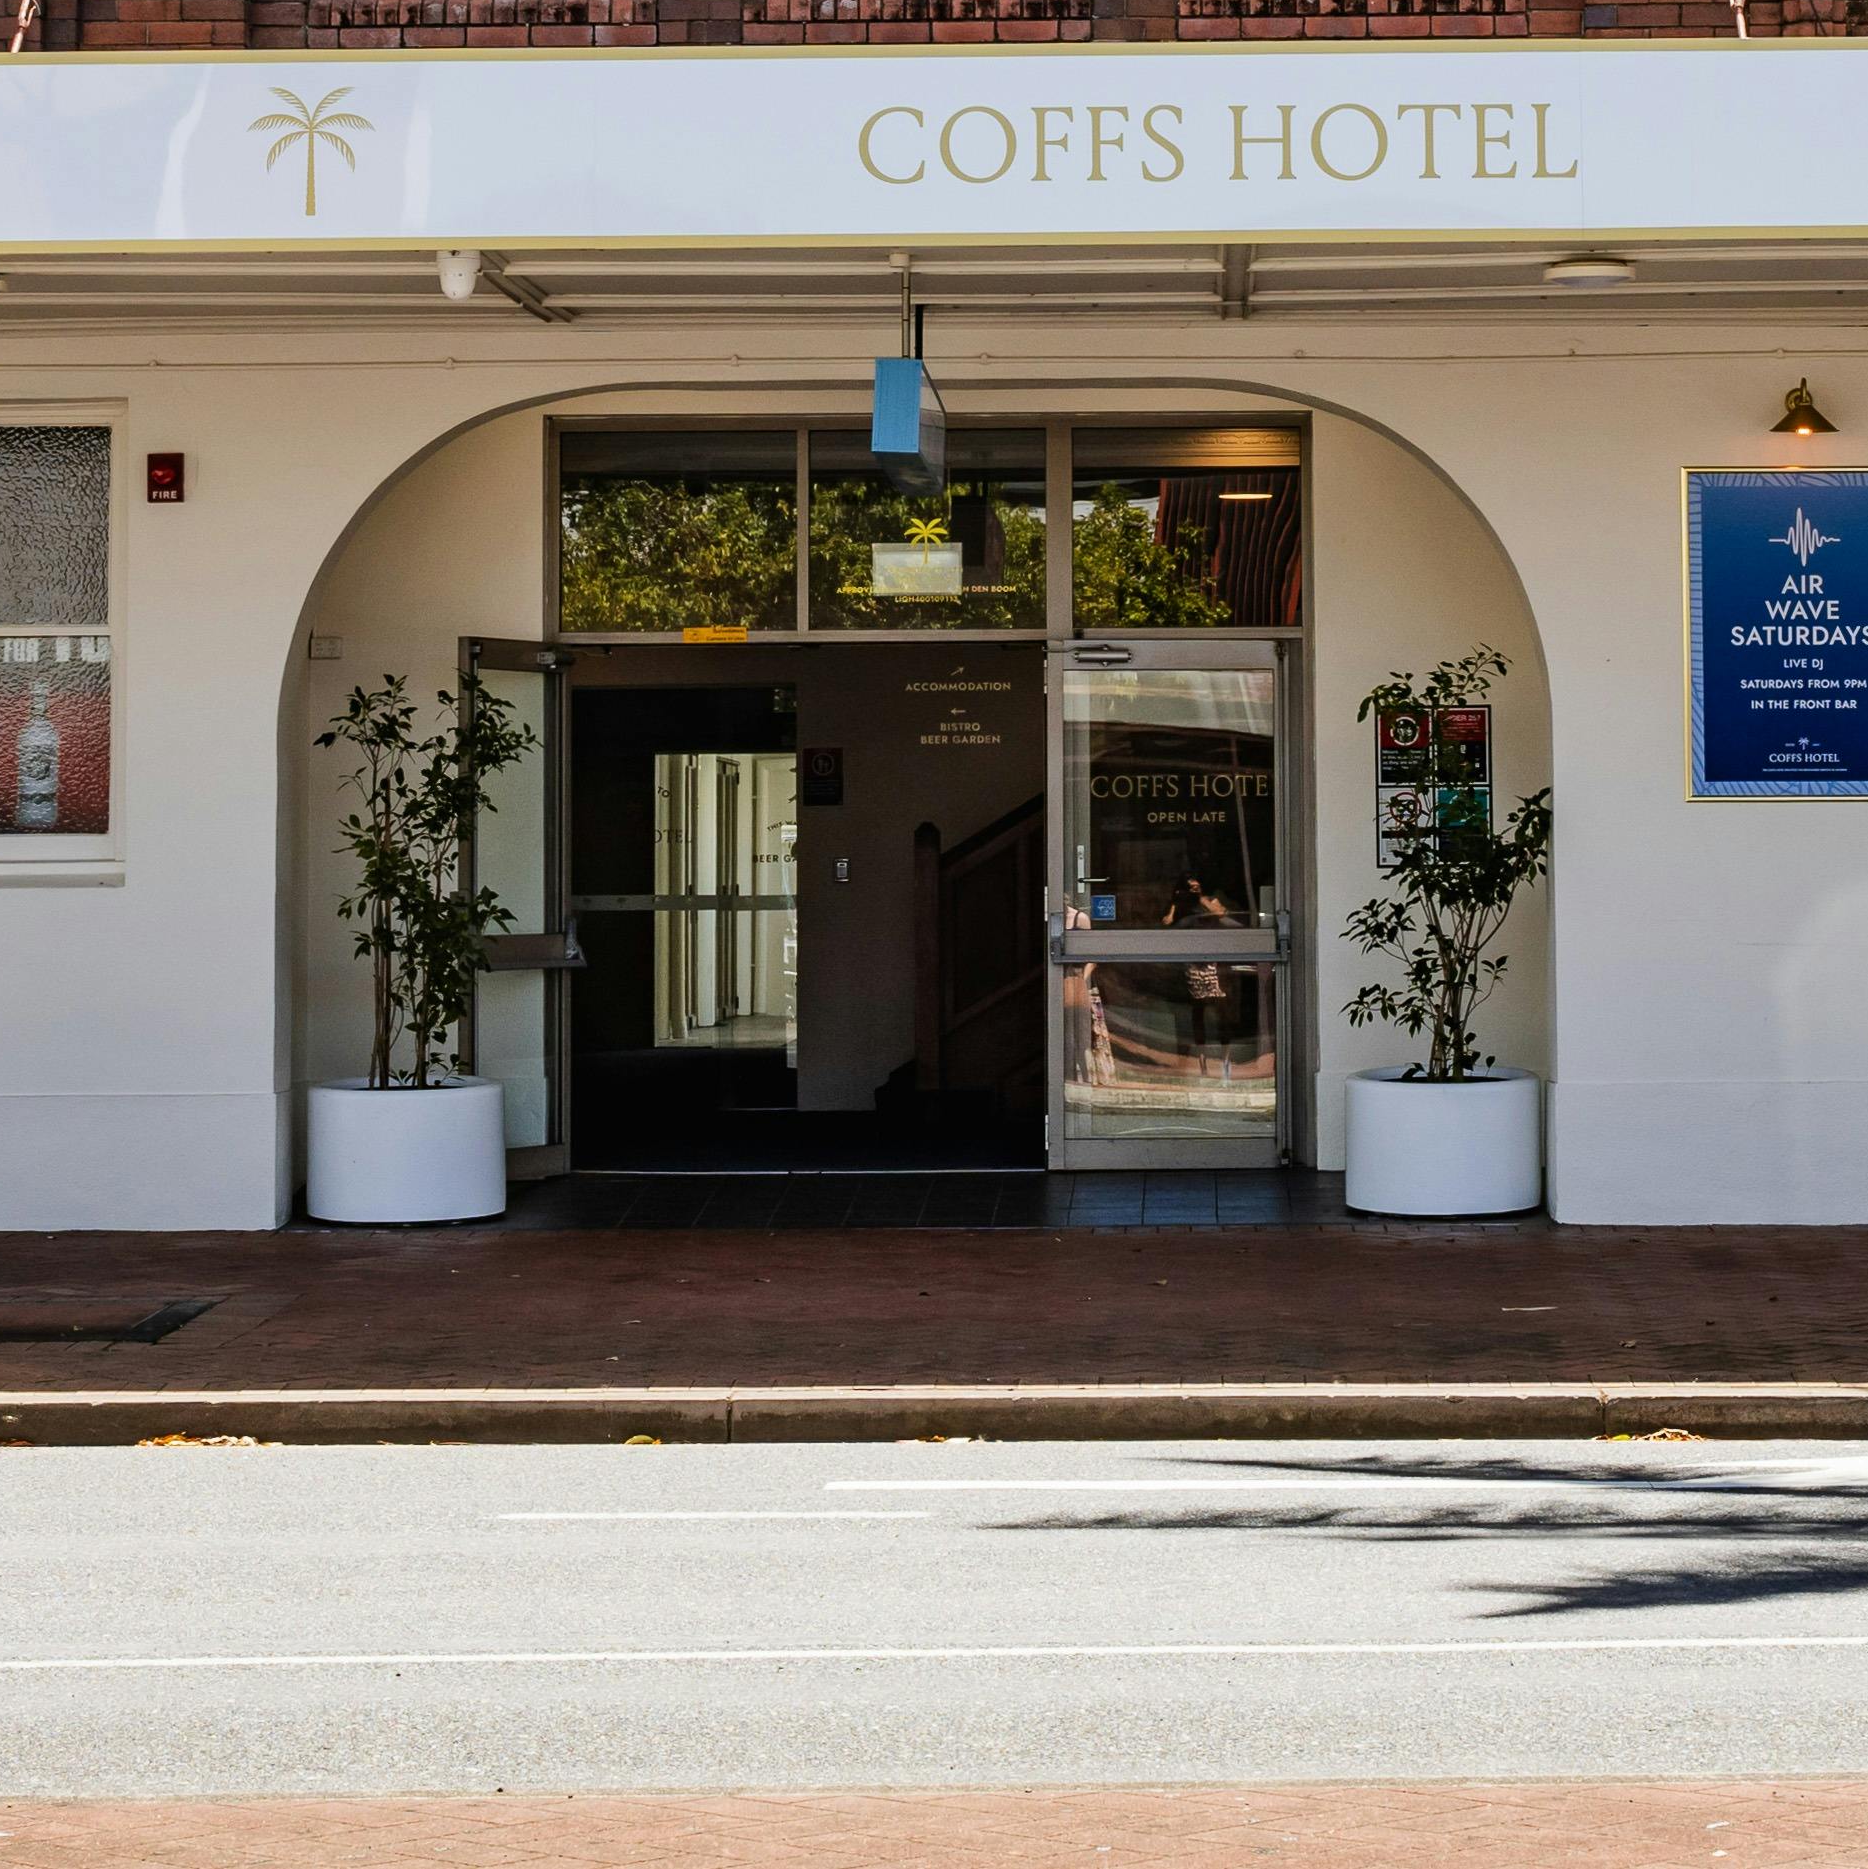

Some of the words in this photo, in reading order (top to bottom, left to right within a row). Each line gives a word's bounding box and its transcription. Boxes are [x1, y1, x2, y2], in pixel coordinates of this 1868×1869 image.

[858, 105, 1188, 186] COFFS
[1226, 101, 1582, 182] HOTEL
[152, 490, 178, 499] FIRE
[1781, 575, 1824, 594] AIR
[1765, 600, 1839, 620] WAVE
[1784, 659, 1807, 668] LIVE
[1812, 659, 1824, 670] DJ
[905, 681, 1011, 692] ACCOMMODATION
[1740, 679, 1804, 689] SATURDAYS
[1808, 679, 1840, 689] FROM
[1844, 679, 1867, 689] 9PM
[1751, 700, 1763, 709] IN
[1768, 700, 1789, 709] THE
[1794, 700, 1831, 709] FRONT
[1835, 700, 1857, 709] BAR
[940, 722, 981, 732] BISTRO
[920, 735, 948, 744] BEER
[951, 734, 1001, 744] GARDEN
[1769, 753, 1802, 763] COFFS
[1805, 753, 1840, 763] HOTEL
[1091, 775, 1179, 798] COFFS
[1190, 775, 1268, 797] HOTE
[1147, 812, 1187, 823] OPEN
[1193, 812, 1226, 823] LATE
